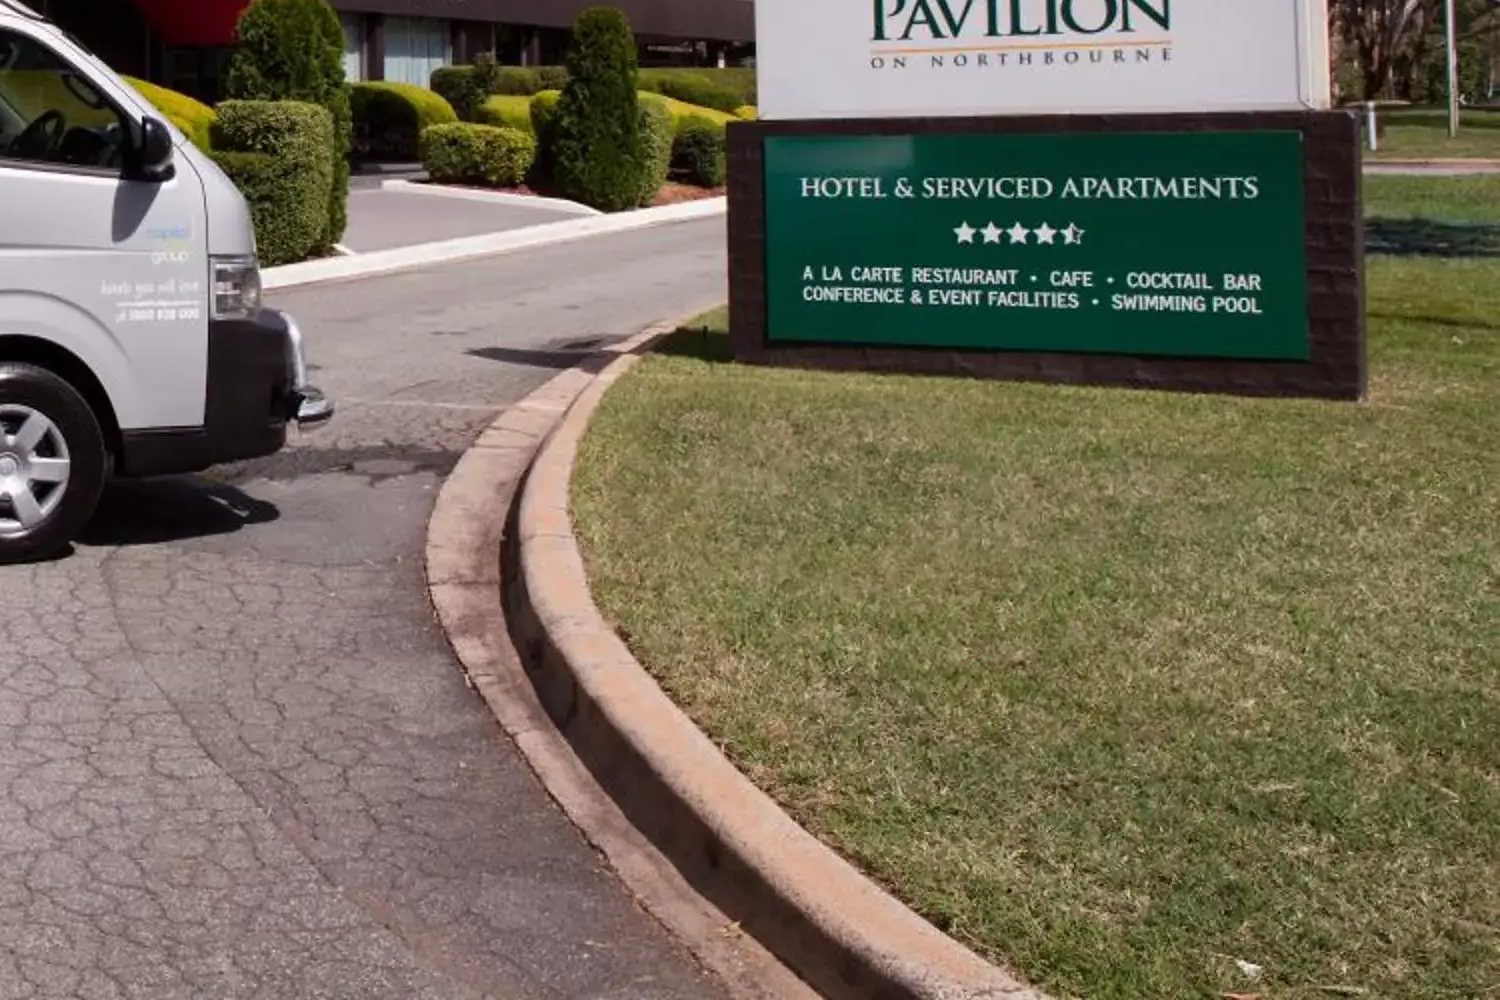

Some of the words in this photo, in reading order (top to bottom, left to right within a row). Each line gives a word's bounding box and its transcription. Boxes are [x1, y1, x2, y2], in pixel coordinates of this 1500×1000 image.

[870, 55, 906, 69] ON
[931, 48, 1173, 68] NORTHBOURNE
[801, 177, 887, 199] HOTEL
[894, 177, 914, 199] &
[922, 177, 1053, 199] SERVICED
[1061, 176, 1260, 199] APARTMENTS
[803, 265, 813, 281] A
[821, 266, 842, 281] LA
[851, 266, 903, 283] CARTE
[911, 268, 1019, 285] RESTAURANT
[1050, 270, 1094, 287] CAFE
[1126, 272, 1213, 289] COCKTAIL
[1223, 273, 1262, 291] BAR
[802, 286, 905, 304] CONFERENCE
[910, 289, 923, 305] &
[929, 289, 982, 306] EVENT
[988, 291, 1080, 309] FACILITIES
[1111, 294, 1206, 312] SWIMMING
[1212, 296, 1263, 314] POOL
